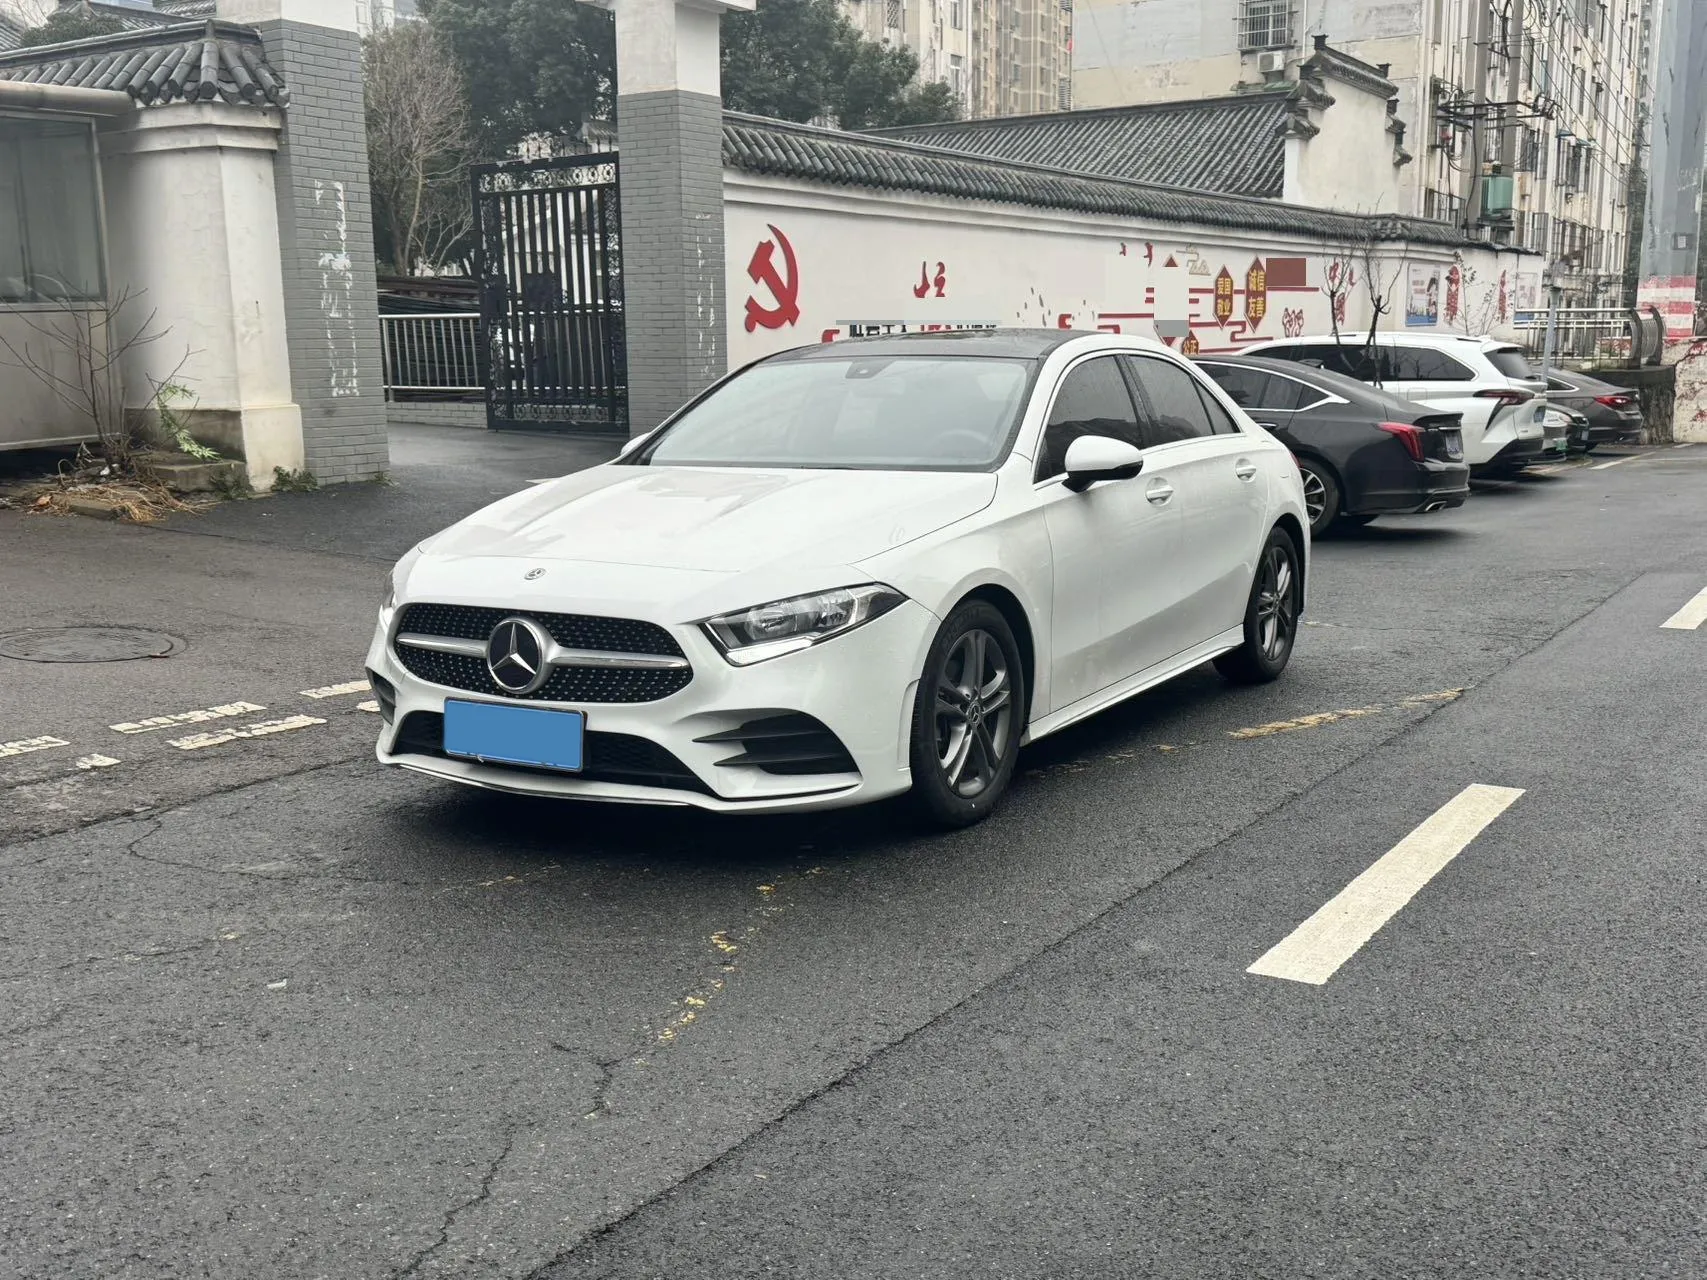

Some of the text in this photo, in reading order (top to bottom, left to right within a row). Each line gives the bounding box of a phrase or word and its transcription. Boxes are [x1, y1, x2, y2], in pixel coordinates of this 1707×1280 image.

[1217, 277, 1232, 295] 爱国
[1248, 269, 1265, 291] 诚信
[1248, 296, 1265, 317] 友善
